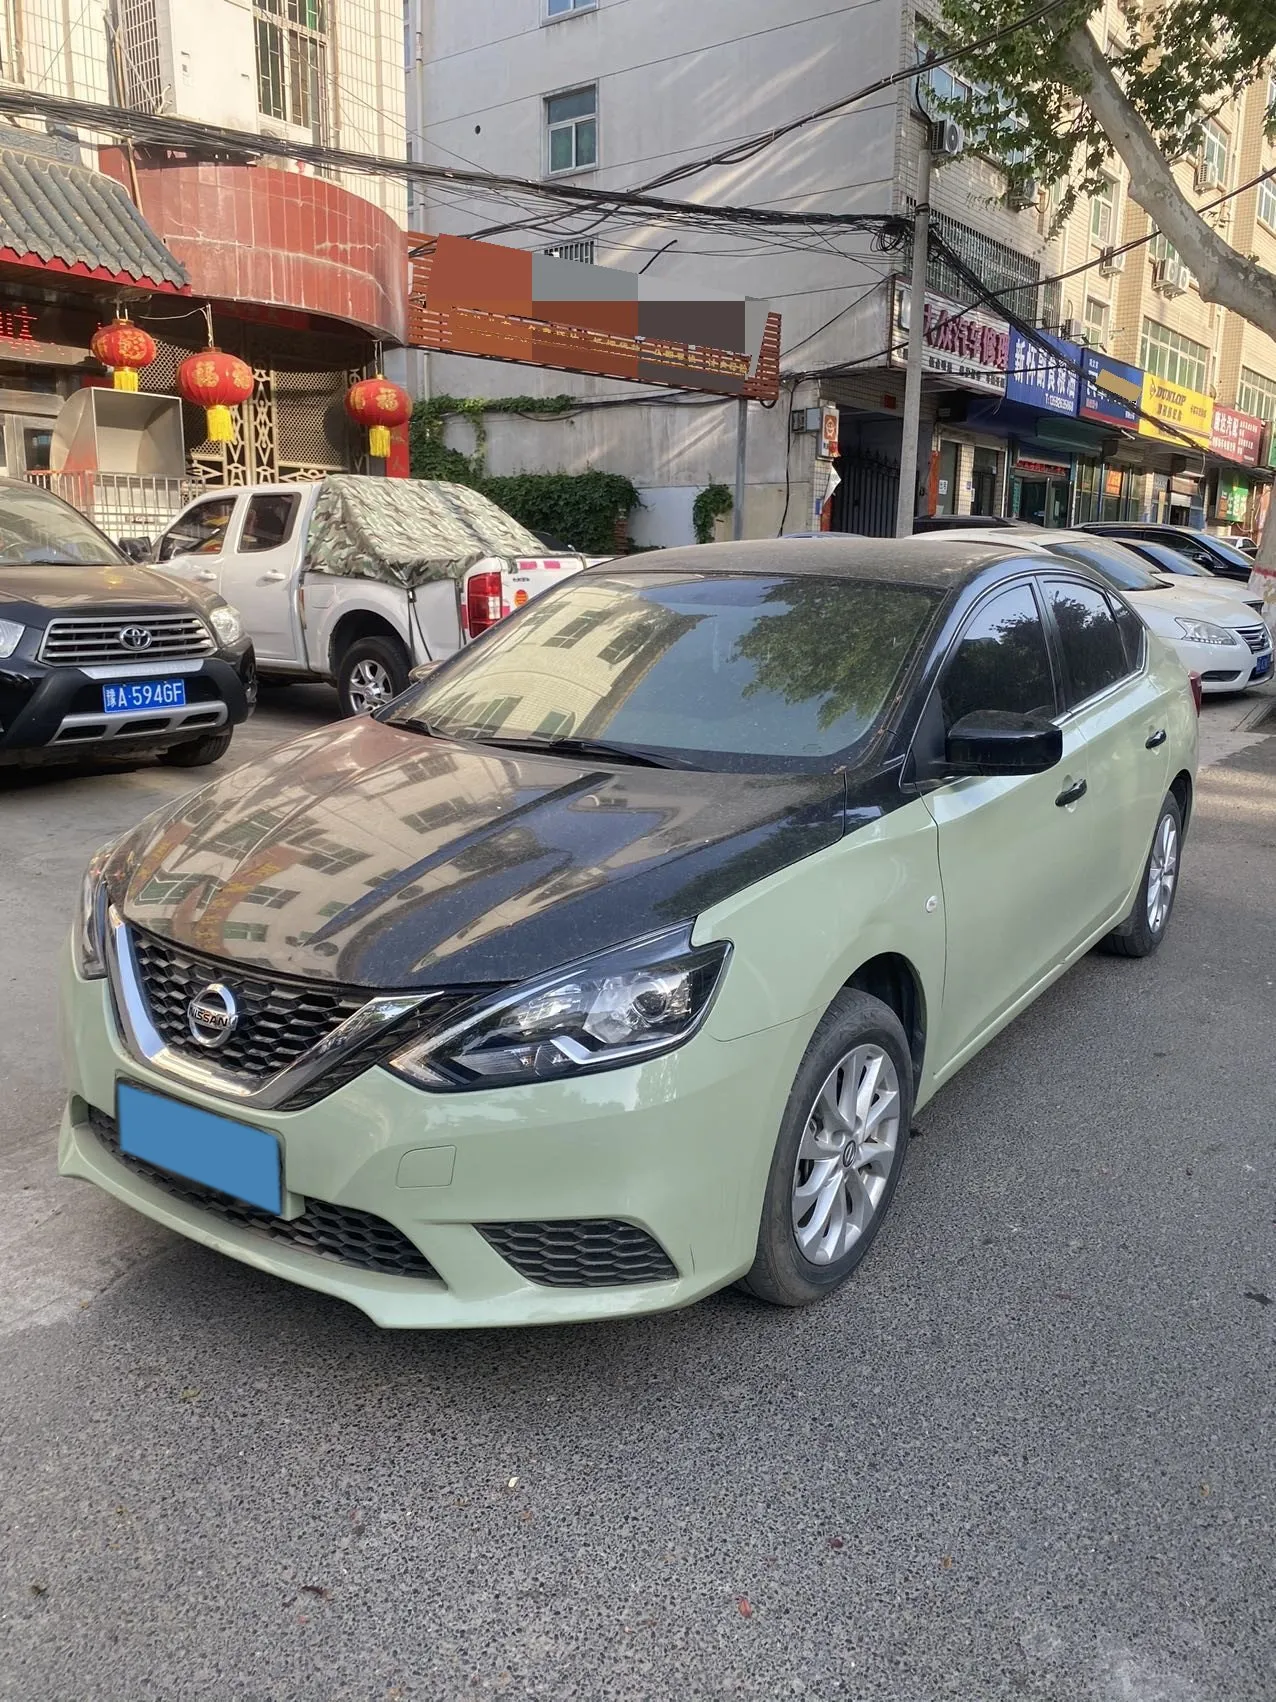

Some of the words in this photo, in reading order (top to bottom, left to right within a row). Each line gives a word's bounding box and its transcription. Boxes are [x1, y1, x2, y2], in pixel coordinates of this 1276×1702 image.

[192, 360, 219, 388] 福
[376, 387, 399, 411] 福
[1155, 386, 1187, 406] DUNLOP
[190, 1004, 229, 1027] NISSAN
